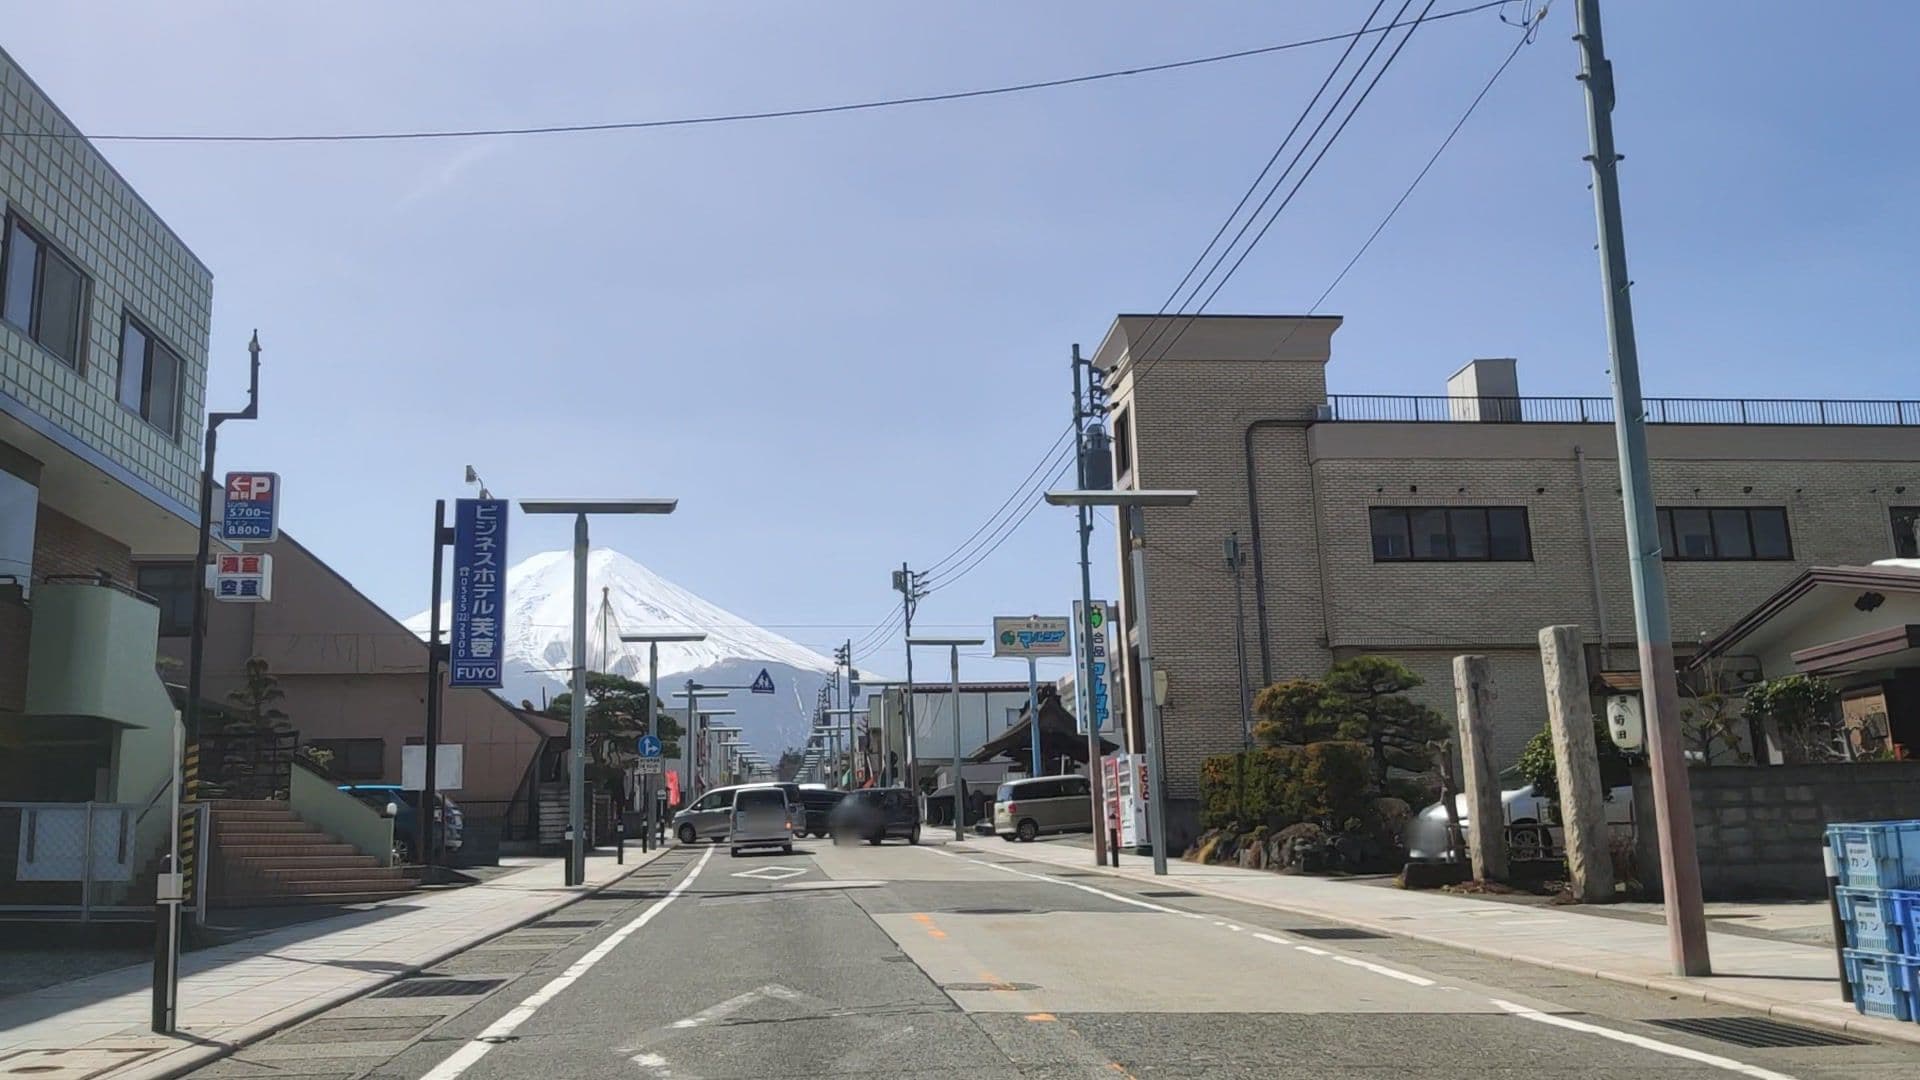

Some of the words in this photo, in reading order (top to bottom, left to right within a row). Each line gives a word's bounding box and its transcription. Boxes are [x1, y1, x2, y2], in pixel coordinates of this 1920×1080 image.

[250, 477, 271, 500] P
[473, 504, 498, 658] ビジネスホテル芙蓉
[456, 666, 497, 679] FUYO
